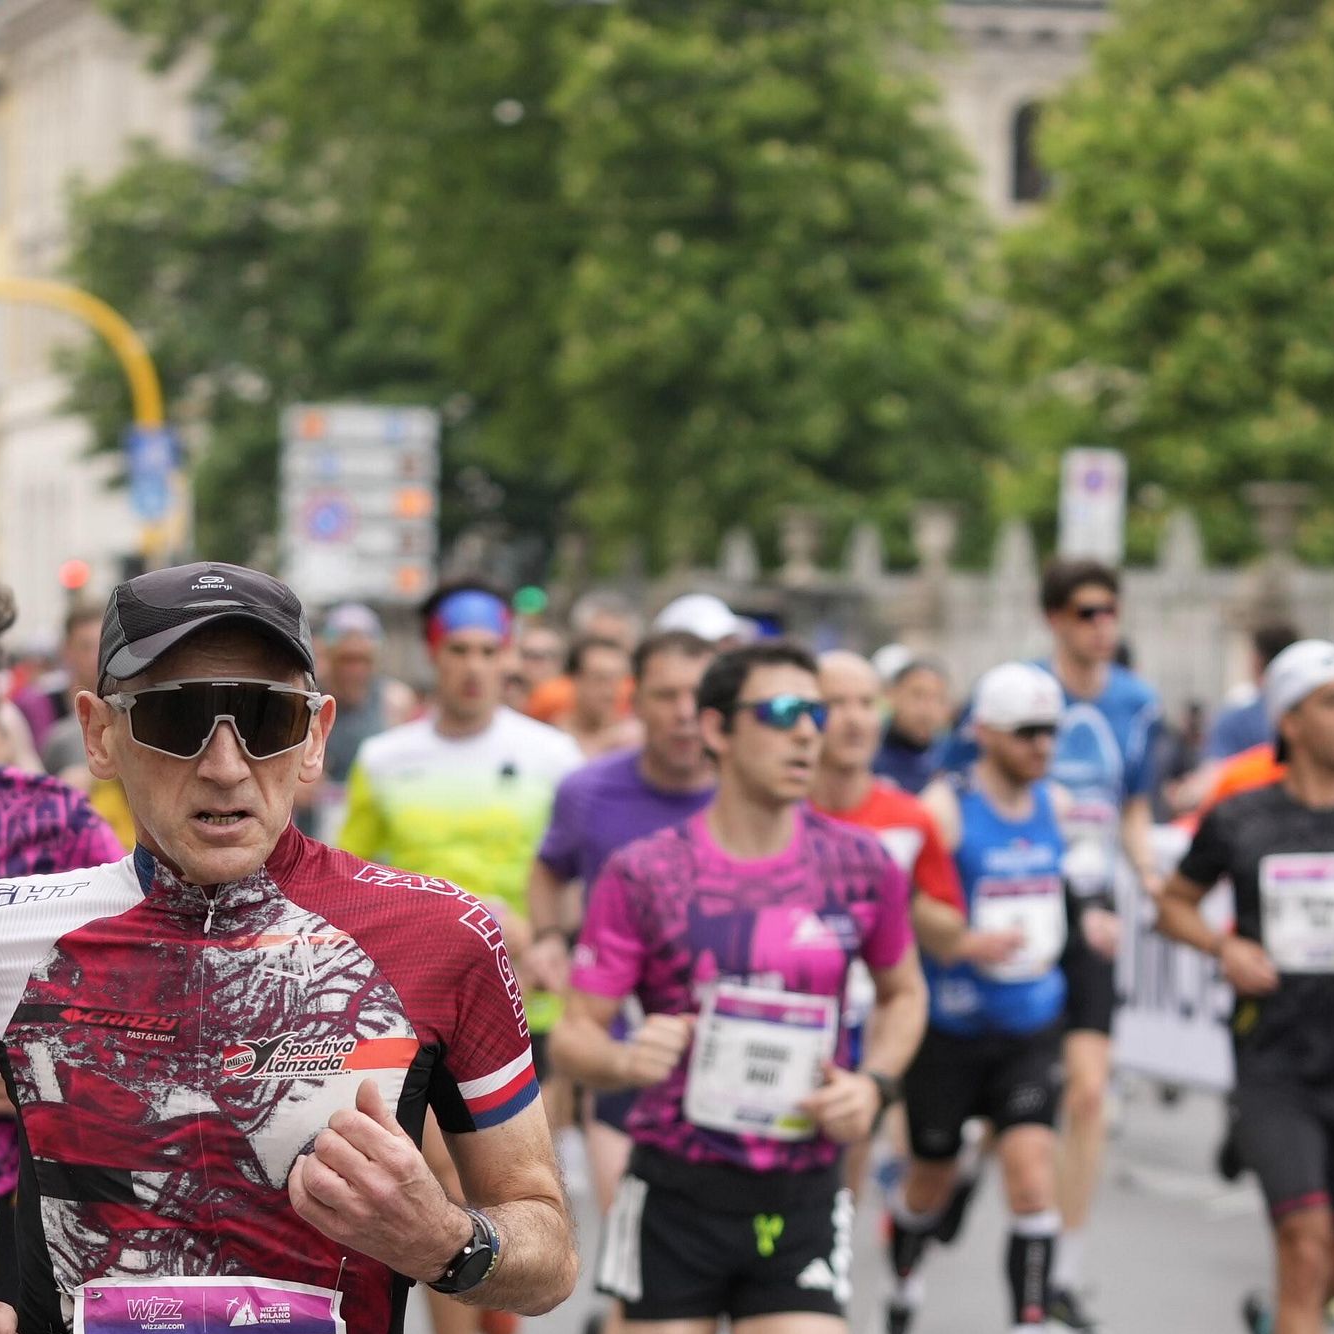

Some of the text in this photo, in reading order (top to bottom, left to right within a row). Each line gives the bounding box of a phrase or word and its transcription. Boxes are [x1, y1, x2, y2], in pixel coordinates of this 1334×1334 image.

[191, 583, 233, 591] Kalenji
[83, 1008, 179, 1030] CRAZY
[126, 1030, 176, 1043] FAST&LIGHT
[278, 1037, 356, 1060] Sportiva
[266, 1054, 344, 1073] Lanzada
[141, 1322, 185, 1330] wizzair.com
